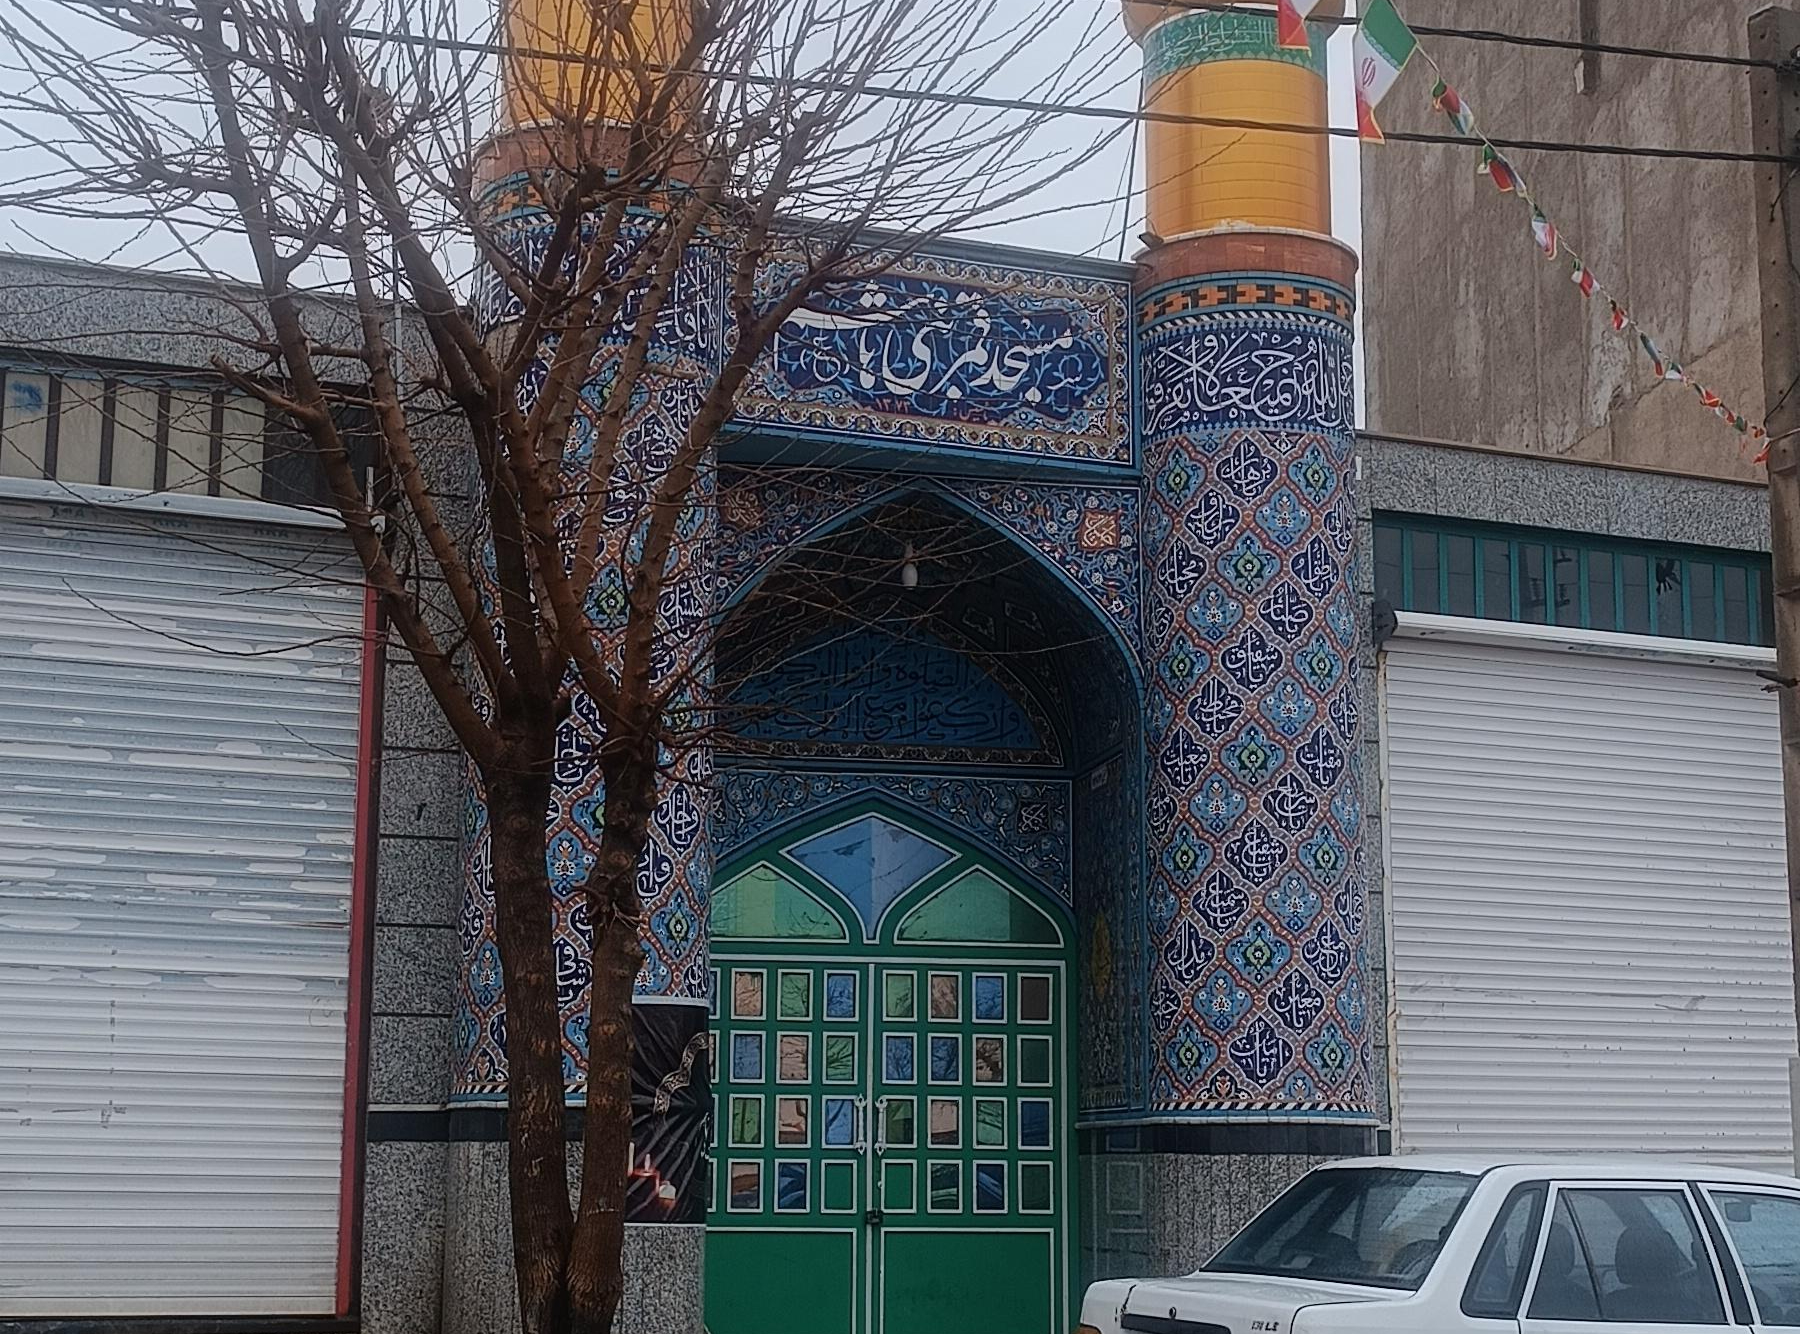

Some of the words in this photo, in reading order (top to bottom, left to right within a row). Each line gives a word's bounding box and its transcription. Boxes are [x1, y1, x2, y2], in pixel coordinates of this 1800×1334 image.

[774, 279, 930, 390] هاشم
[883, 297, 962, 400] بنی
[929, 291, 991, 395] قمر
[969, 328, 1073, 405] مسجد
